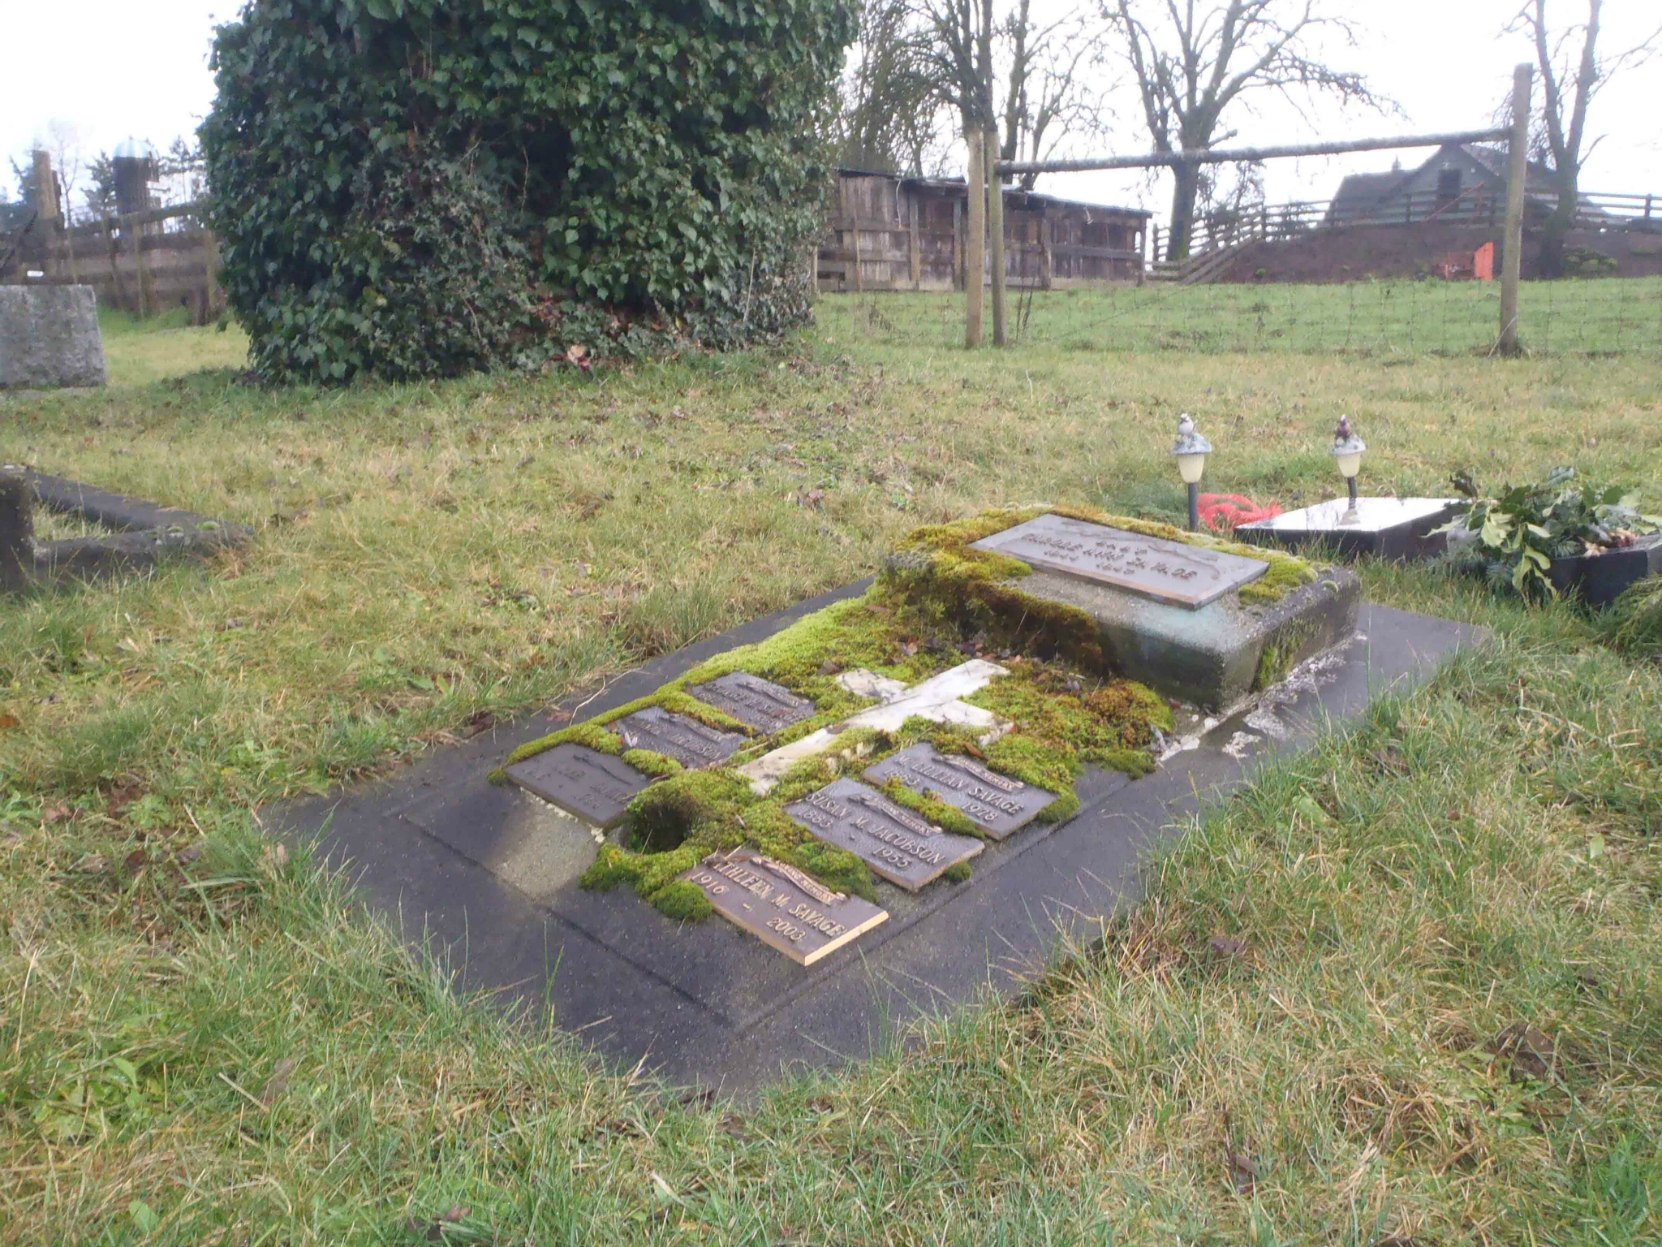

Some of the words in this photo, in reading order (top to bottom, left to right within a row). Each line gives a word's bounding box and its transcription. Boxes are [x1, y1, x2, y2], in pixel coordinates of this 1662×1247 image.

[960, 802, 999, 822] 1978
[968, 786, 1025, 815] SAVAGE
[805, 792, 849, 818] SUSAN
[868, 825, 946, 866] JACOBSON
[873, 846, 912, 868] 1955
[691, 871, 728, 895] 1916
[766, 916, 807, 942] 2003
[787, 902, 849, 938] SAVAGE
